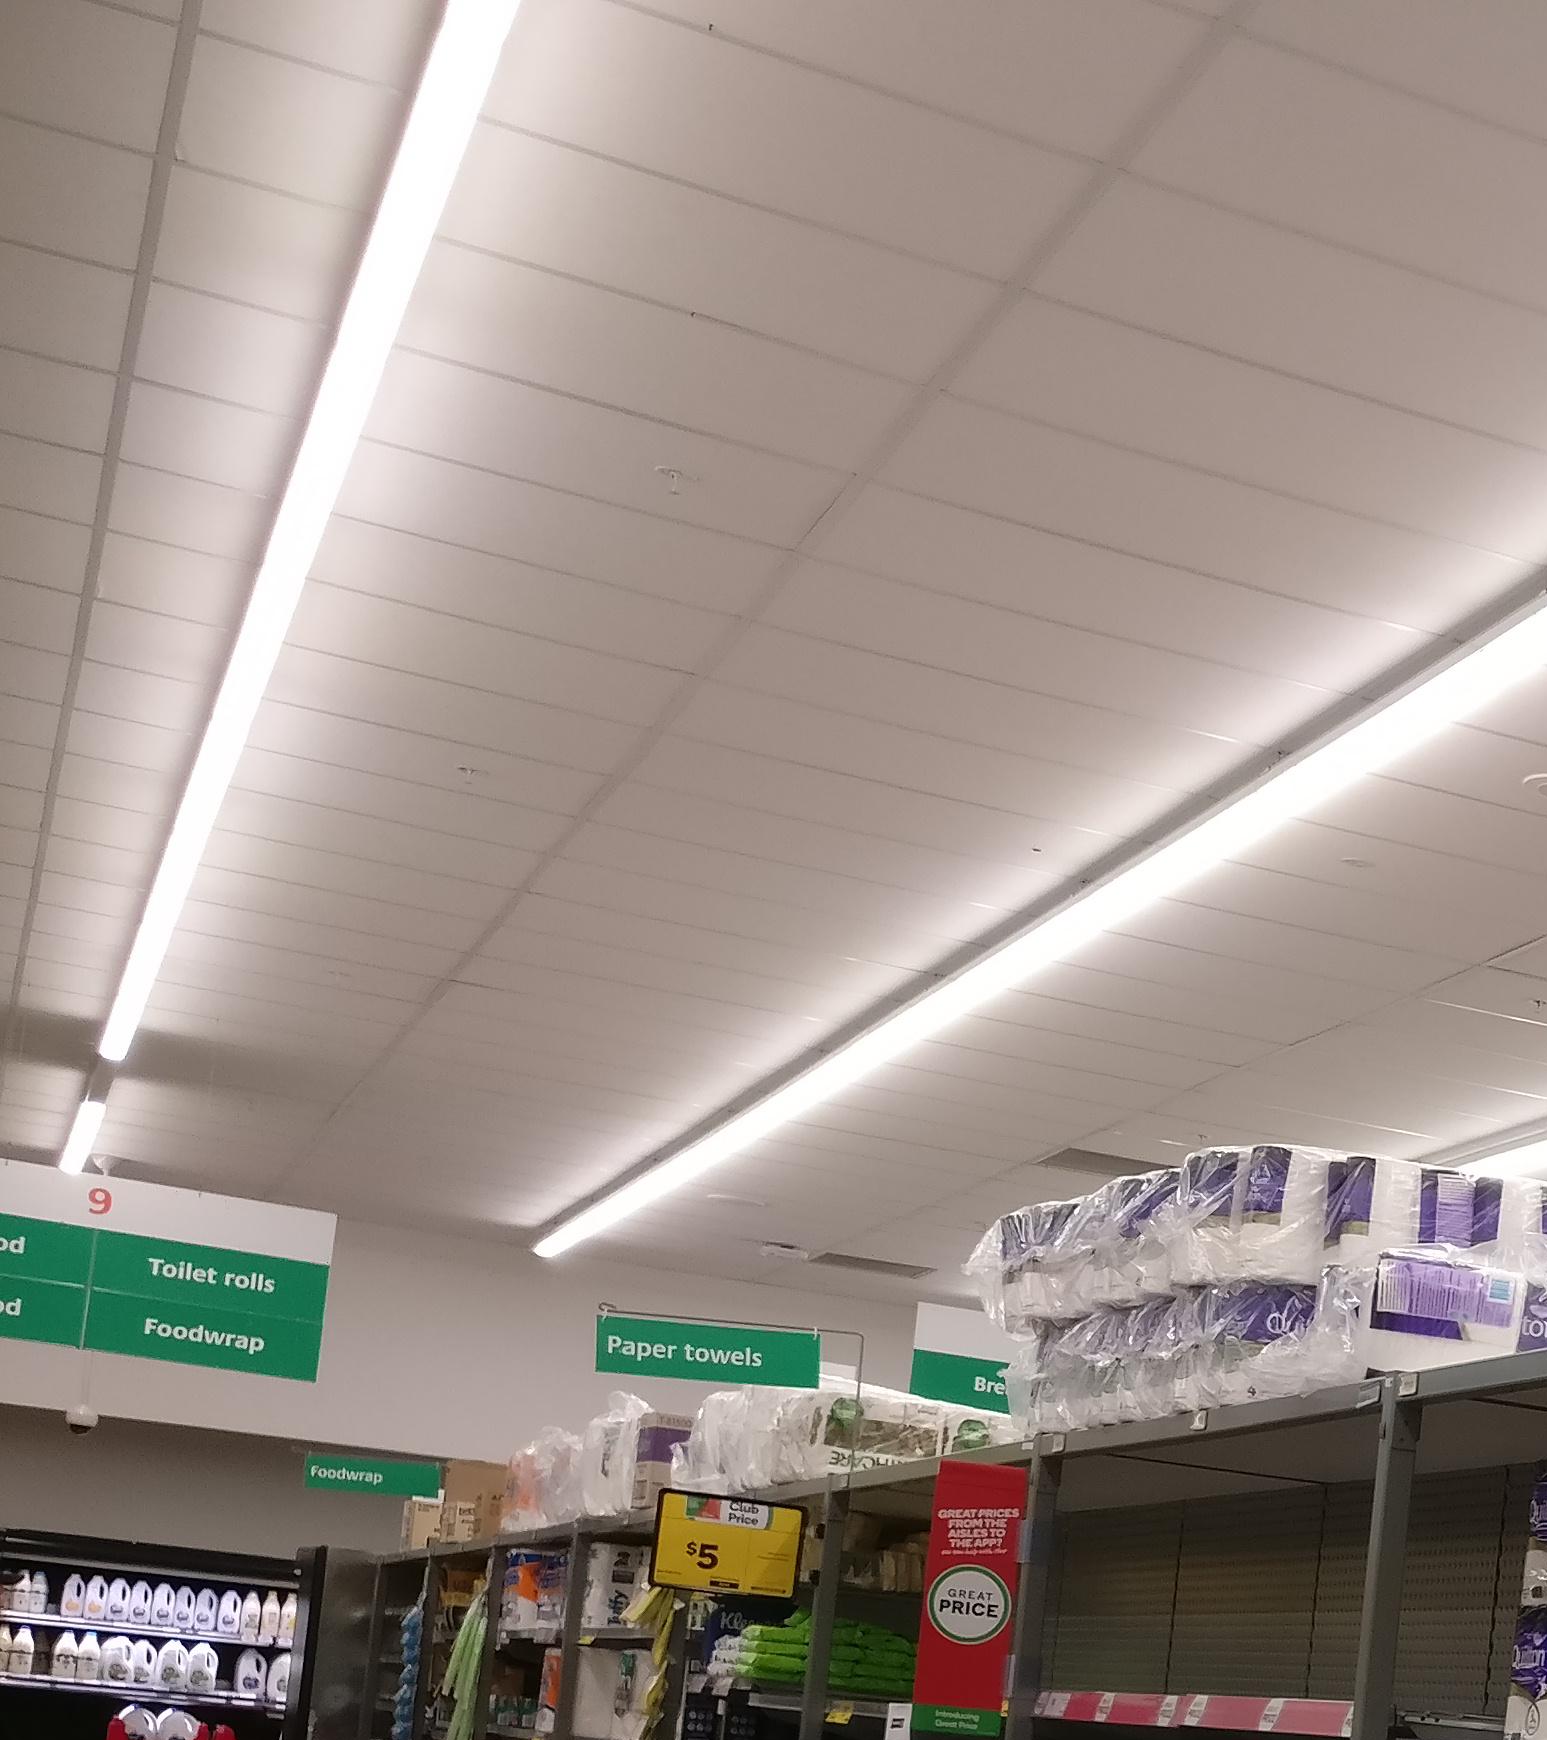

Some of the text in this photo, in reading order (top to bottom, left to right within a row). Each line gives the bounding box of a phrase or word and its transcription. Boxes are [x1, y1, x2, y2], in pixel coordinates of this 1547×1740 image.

[88, 1188, 113, 1215] 9
[148, 1257, 276, 1294] Toilet rolls
[144, 1317, 265, 1355] Foodwrap
[607, 1335, 763, 1368] Paper towels
[974, 1375, 1009, 1396] Bre
[311, 1464, 383, 1486] Foodwrap
[729, 1500, 759, 1515] Club
[937, 1508, 1020, 1519] GREAT PRICES
[728, 1513, 759, 1526] Price
[948, 1518, 1007, 1529] FROM THE
[948, 1528, 1006, 1538] AISLES TO
[949, 1538, 972, 1548] THE
[686, 1541, 719, 1570] $5
[948, 1588, 993, 1601] GREAT
[939, 1599, 999, 1618] PRICE
